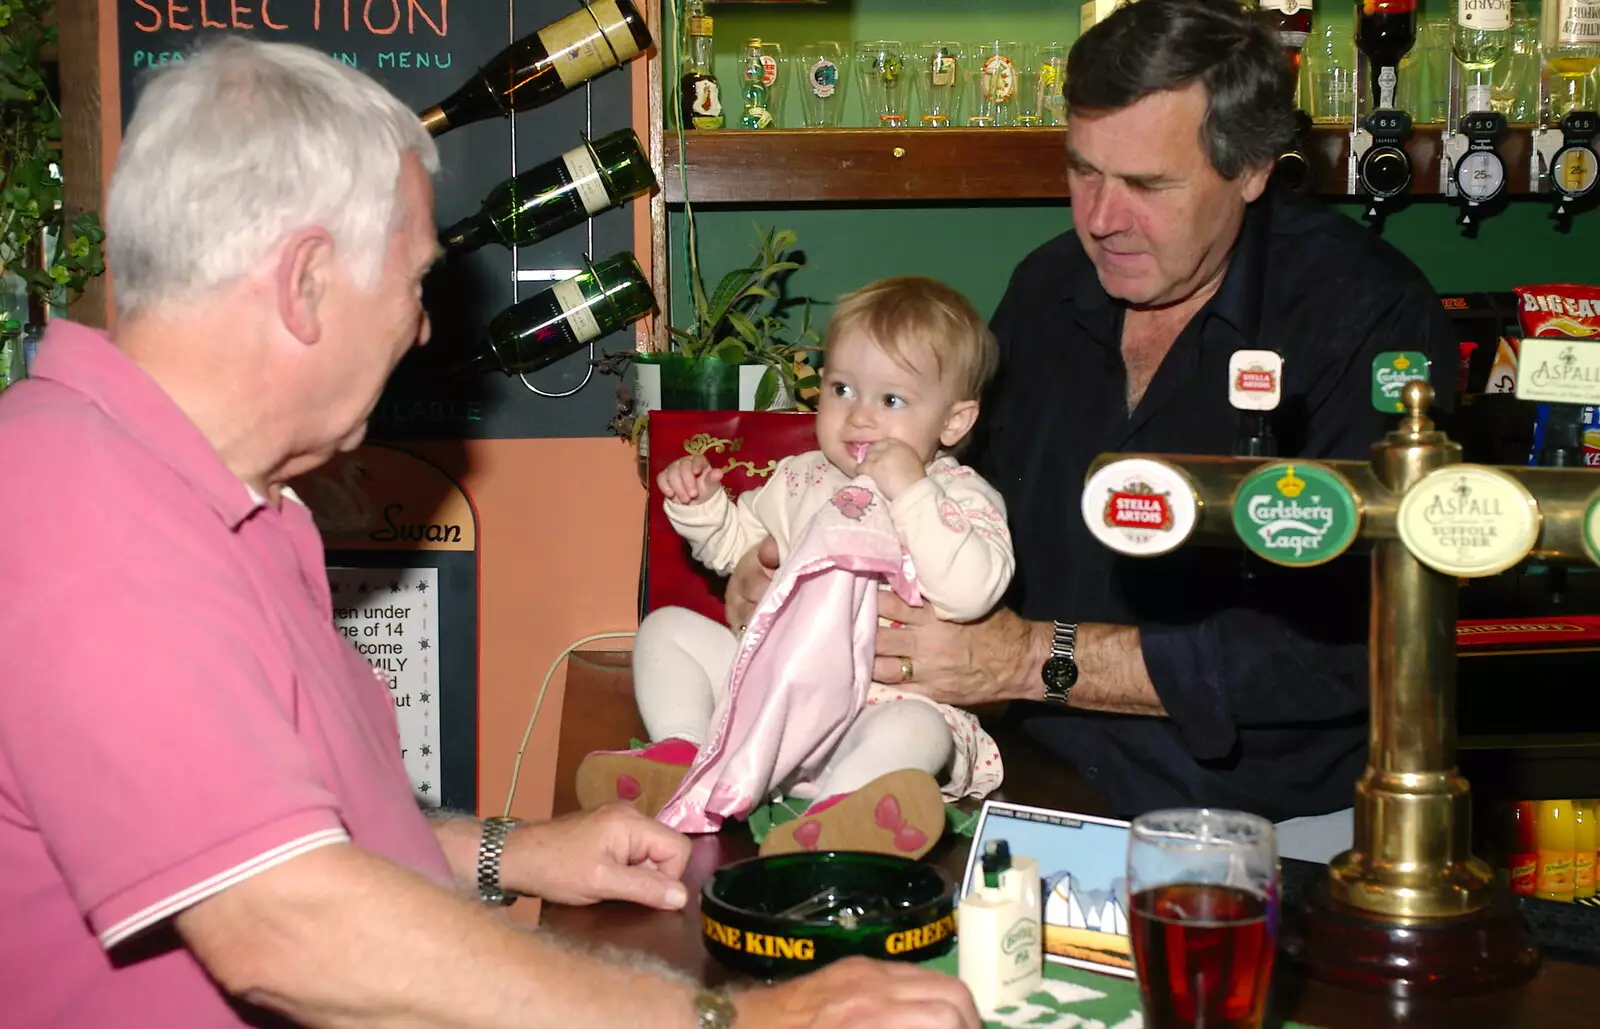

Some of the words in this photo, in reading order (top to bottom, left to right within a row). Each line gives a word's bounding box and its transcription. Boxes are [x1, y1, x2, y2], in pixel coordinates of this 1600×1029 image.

[134, 0, 447, 37] SELECTION
[133, 50, 200, 69] PLEA
[378, 51, 453, 69] MENU
[1116, 498, 1162, 512] STELLA
[1423, 494, 1504, 525] ASPALL
[370, 503, 462, 542] Swan
[1116, 511, 1162, 524] ARTOIS
[1248, 495, 1334, 533] Carlsberg
[1432, 526, 1498, 537] SUFFOLK
[1265, 530, 1323, 558] Lager
[1440, 537, 1492, 548] CYDER
[333, 607, 358, 619] ren
[364, 605, 411, 619] under
[339, 625, 358, 640] ge
[364, 623, 380, 637] of
[385, 623, 404, 637] 14
[354, 641, 403, 655] lcome
[368, 658, 408, 672] MILY
[395, 694, 411, 707] ut
[702, 916, 742, 950] ENE
[745, 931, 816, 960] KING
[885, 916, 957, 955] GREEN
